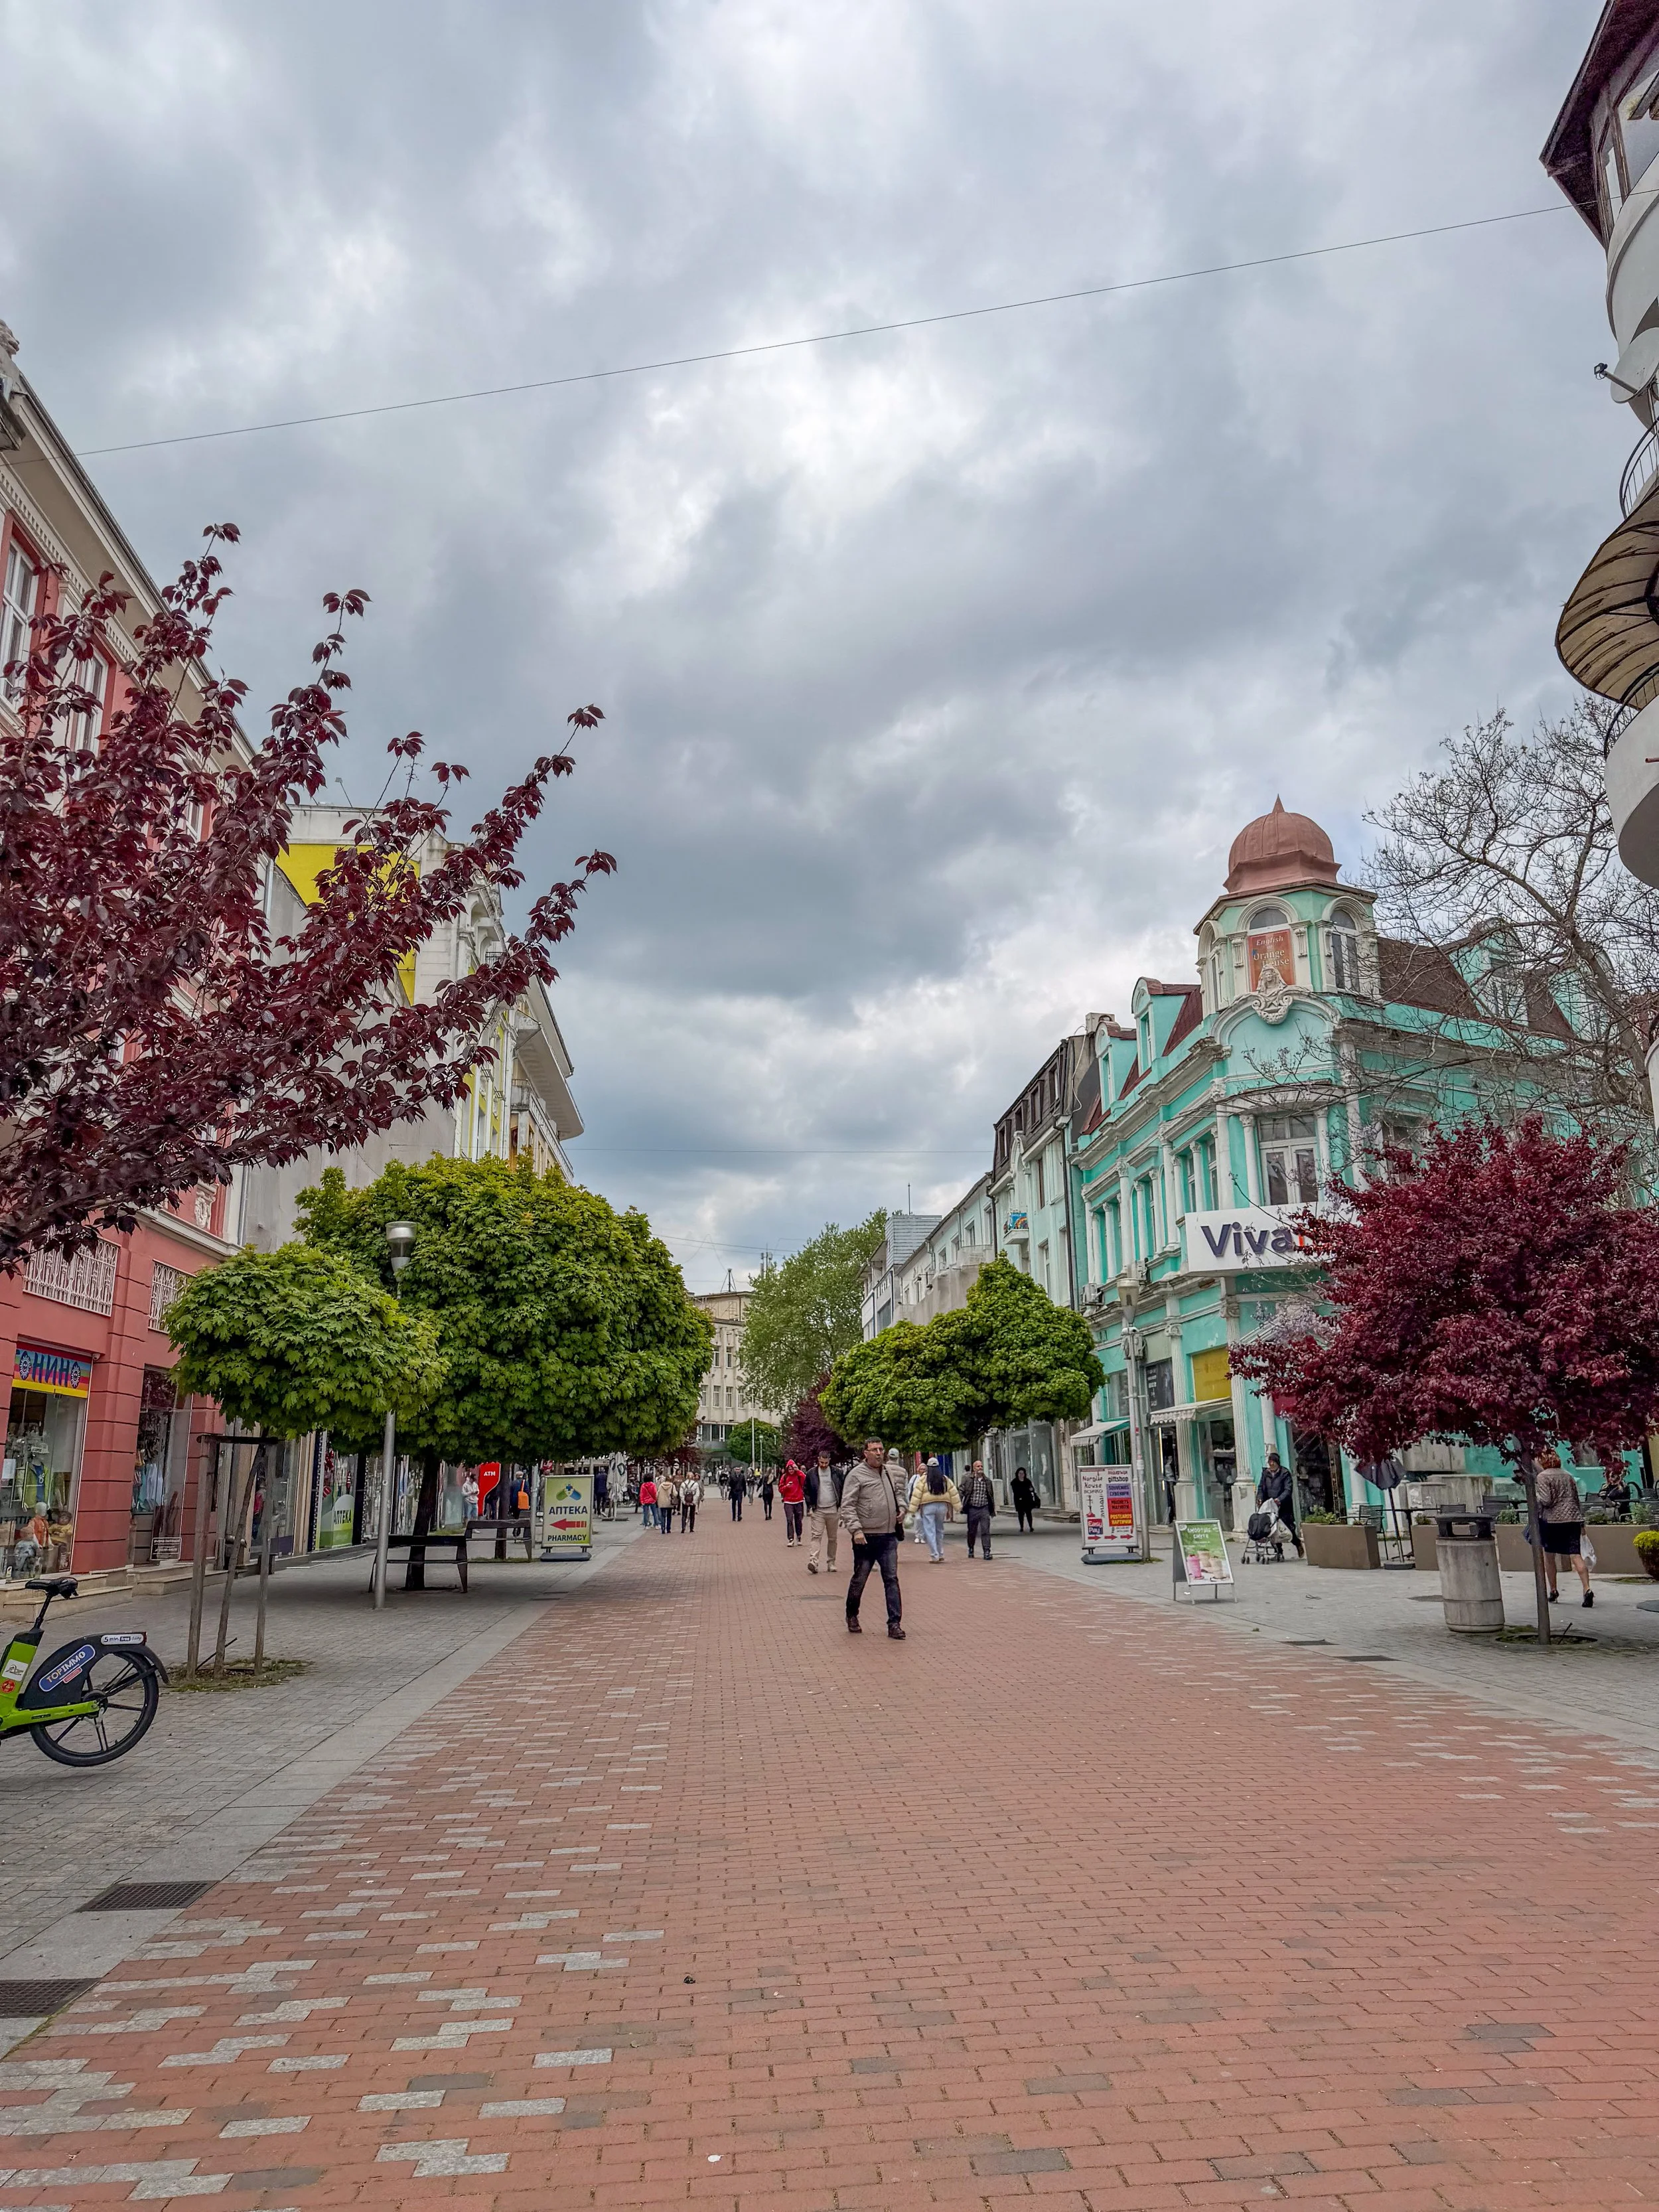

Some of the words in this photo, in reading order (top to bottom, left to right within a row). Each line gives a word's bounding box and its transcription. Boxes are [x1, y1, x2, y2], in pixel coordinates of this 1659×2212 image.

[1200, 1221, 1305, 1257] Viva
[334, 1510, 352, 1524] АПТЕКА
[549, 1506, 588, 1514] АПТЕКА
[46, 1651, 86, 1683] TOPIMMO
